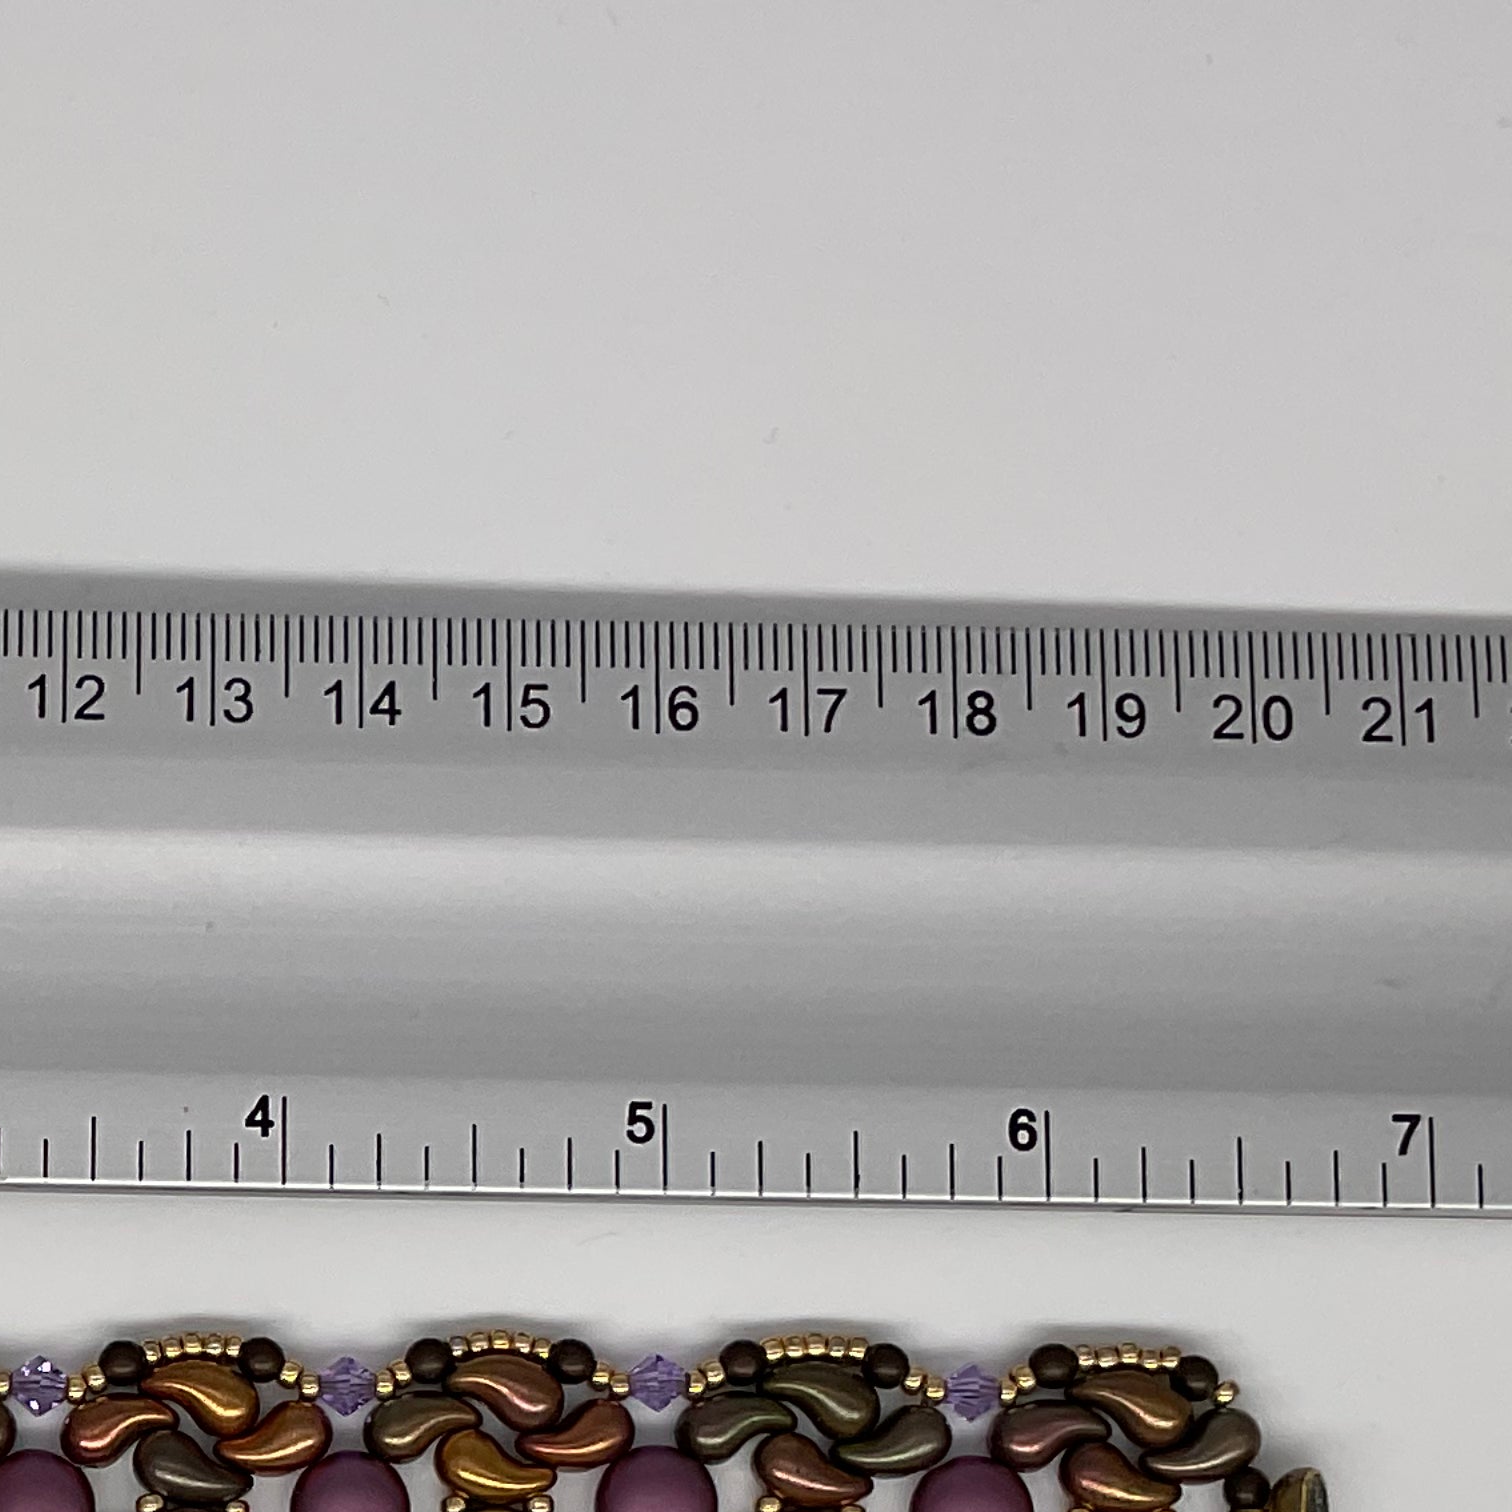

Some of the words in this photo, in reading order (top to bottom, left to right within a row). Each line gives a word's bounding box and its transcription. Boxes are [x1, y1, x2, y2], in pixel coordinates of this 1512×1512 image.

[28, 673, 105, 721] 12
[176, 676, 254, 724] 13
[323, 679, 402, 726] 14
[472, 682, 551, 729] 15
[620, 684, 699, 732] 16
[768, 687, 848, 734] 17
[918, 689, 997, 737] 18
[1067, 691, 1147, 739] 19
[1212, 693, 1293, 742] 20
[1361, 696, 1435, 744] 21
[244, 1094, 275, 1138] 4
[626, 1100, 655, 1144] 5
[1008, 1108, 1038, 1152] 6
[1391, 1113, 1422, 1156] 7
